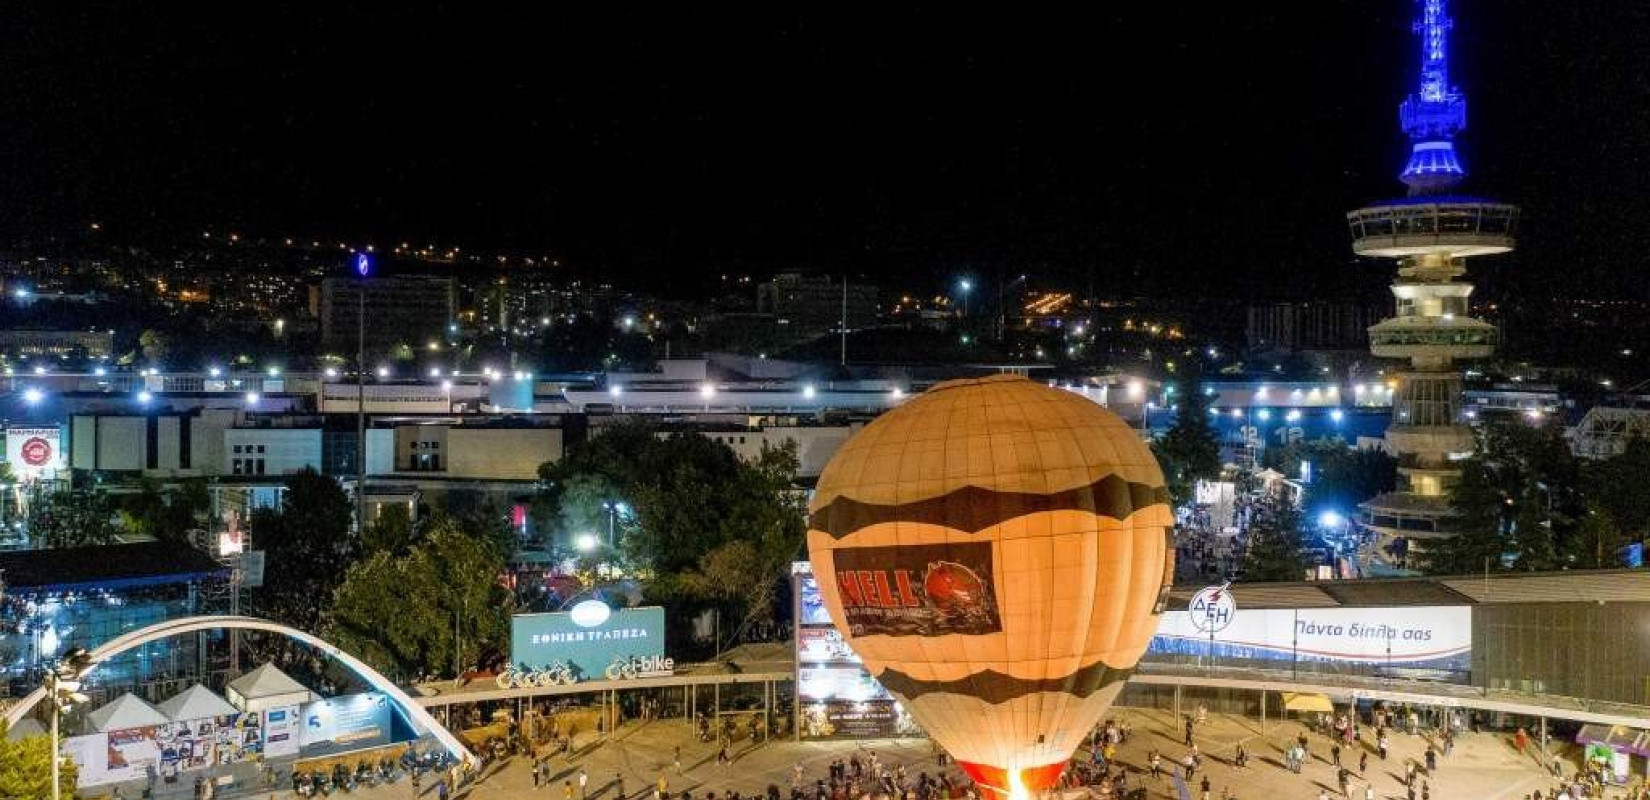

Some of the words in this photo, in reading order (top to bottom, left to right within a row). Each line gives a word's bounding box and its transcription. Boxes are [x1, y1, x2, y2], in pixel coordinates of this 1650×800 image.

[837, 570, 919, 607] HELL
[1193, 597, 1229, 623] ΔΕΗ
[532, 631, 584, 644] ΕΘΝΙΚΗ
[587, 628, 648, 641] ΤΡΑΠΕΖΑ
[1296, 620, 1343, 636] Πάντα
[1349, 623, 1397, 640] δίπλα
[1402, 626, 1432, 641] σας
[632, 655, 675, 673] i-bike
